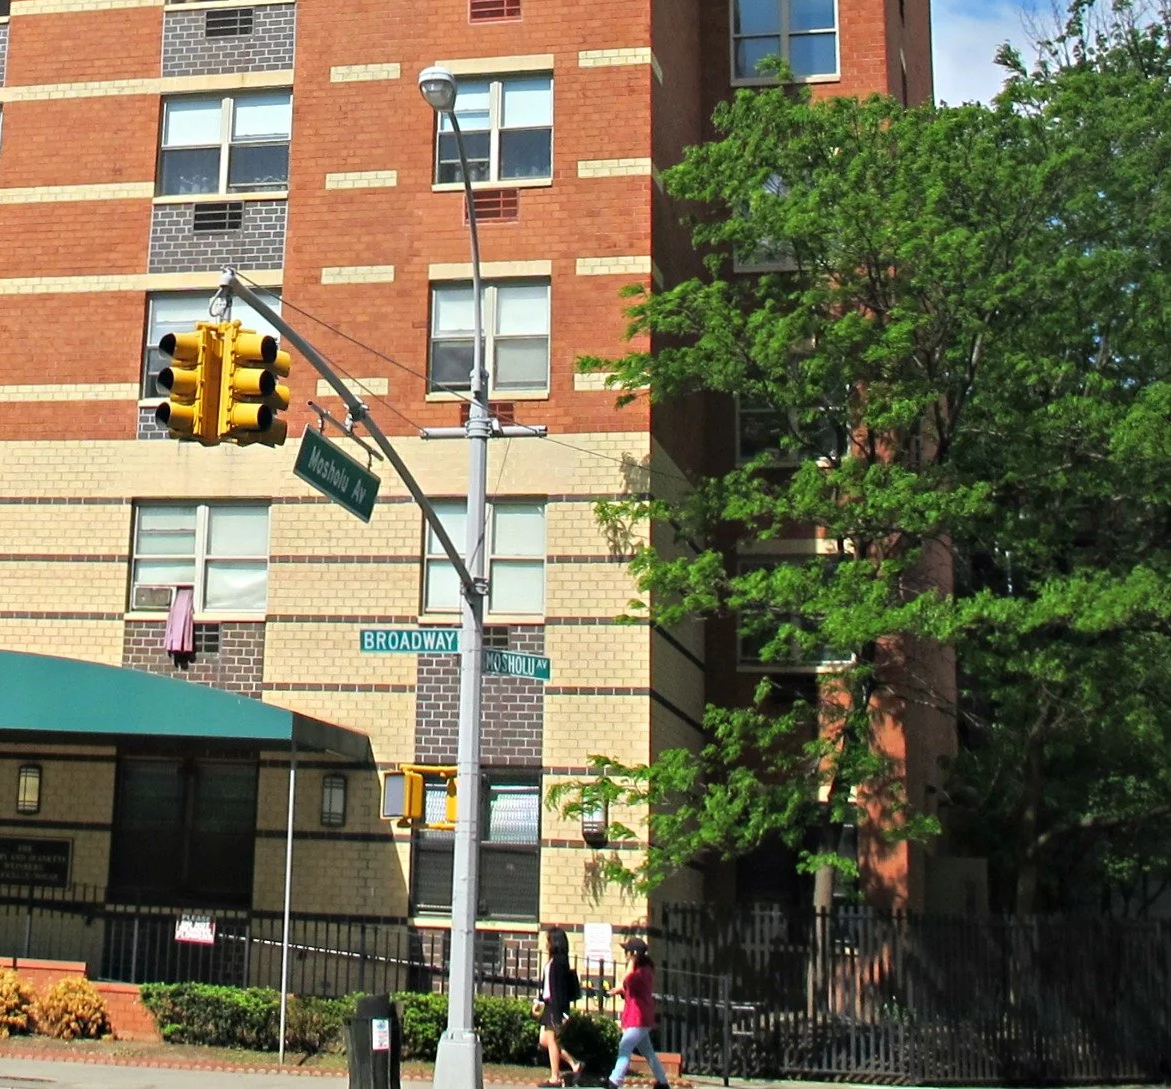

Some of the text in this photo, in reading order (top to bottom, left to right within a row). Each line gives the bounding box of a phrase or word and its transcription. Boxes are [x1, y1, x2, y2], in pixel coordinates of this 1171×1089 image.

[308, 445, 367, 504] Mosholu Av
[363, 631, 456, 651] BROADWAY
[485, 652, 548, 676] MOSHOLU AV
